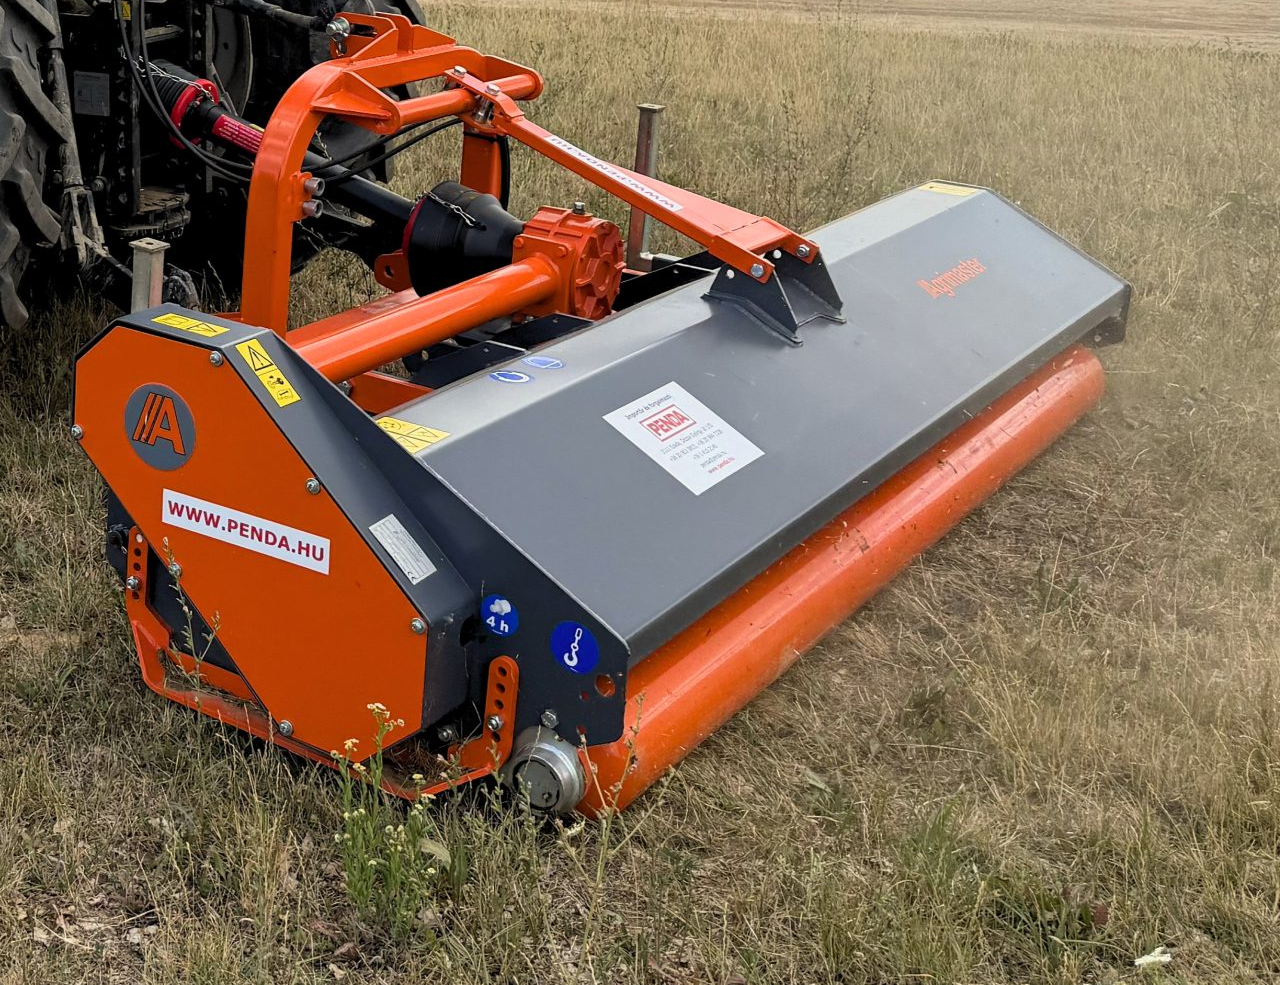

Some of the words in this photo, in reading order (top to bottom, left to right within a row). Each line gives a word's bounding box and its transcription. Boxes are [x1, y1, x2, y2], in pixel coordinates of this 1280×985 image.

[646, 410, 690, 436] PENDA
[167, 499, 325, 562] WWW.PENDA.HU
[486, 615, 496, 628] 4
[500, 619, 509, 633] h
